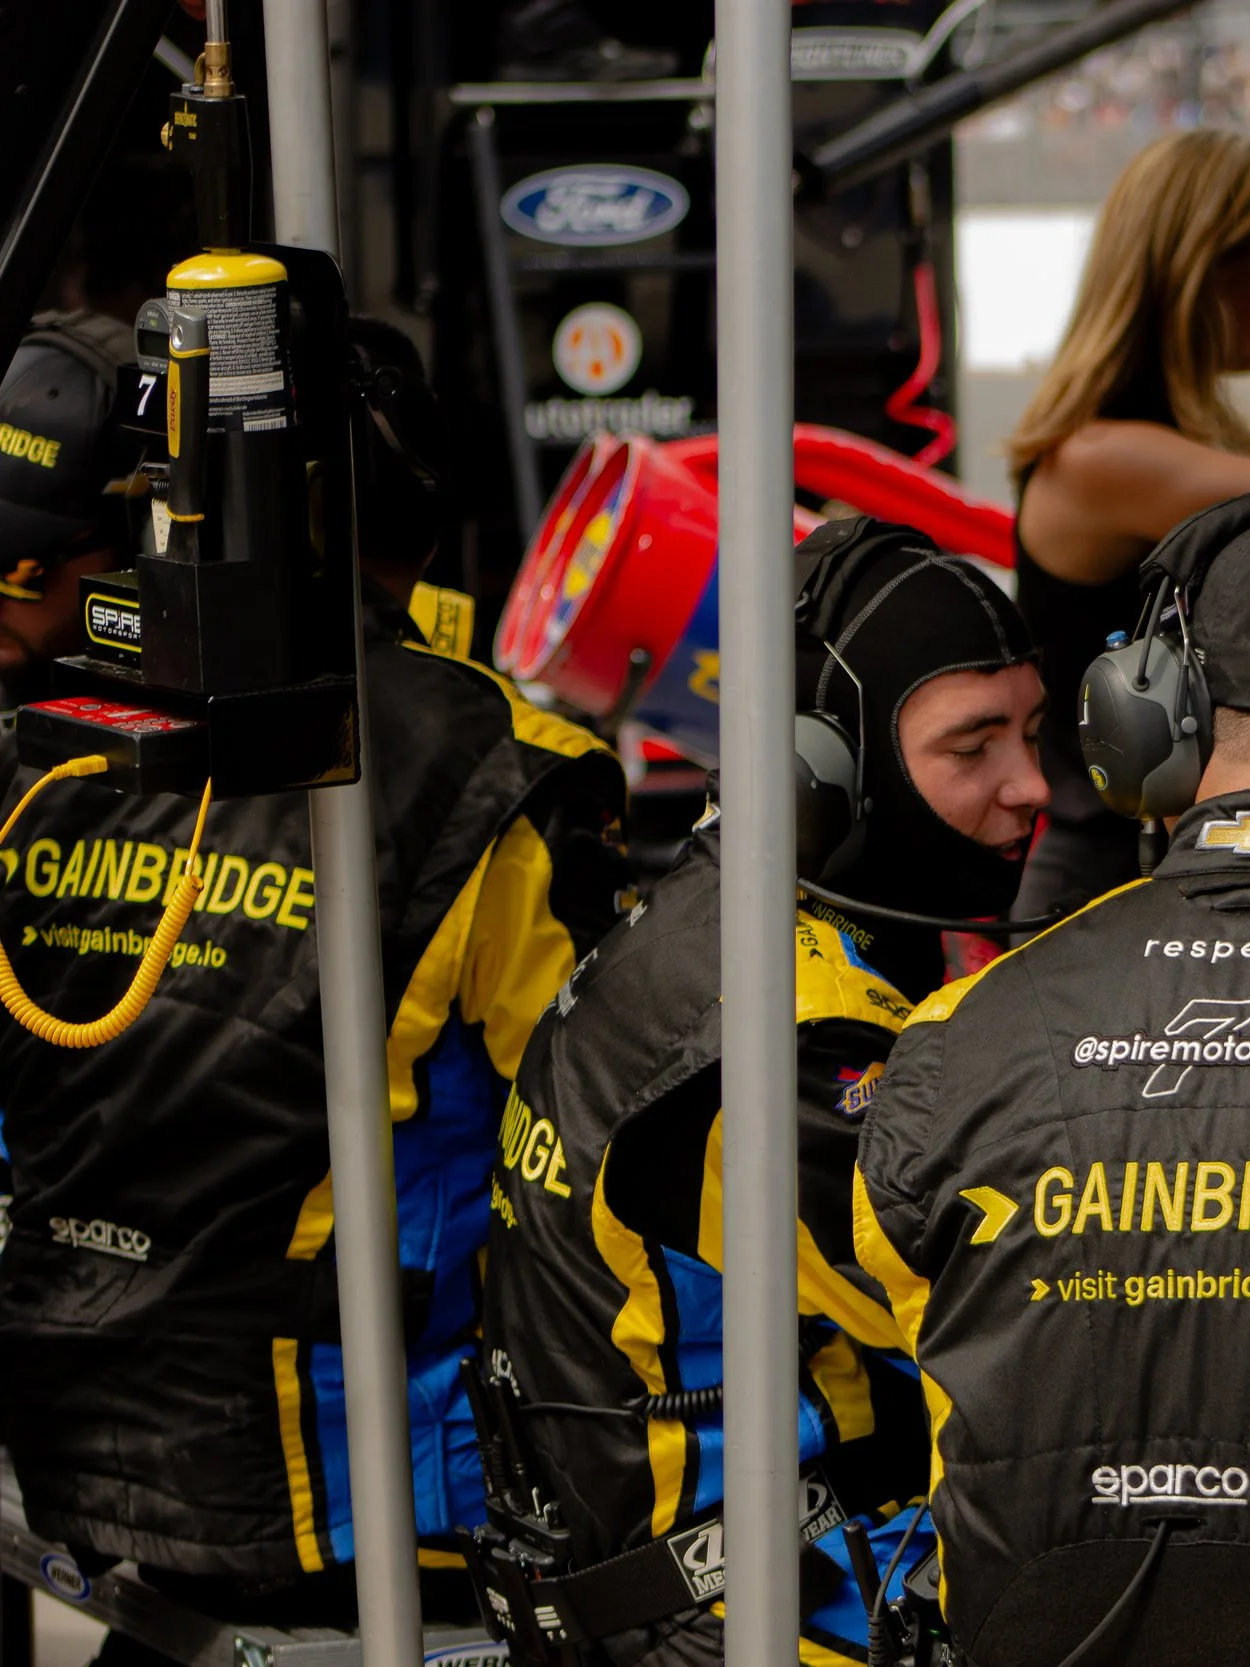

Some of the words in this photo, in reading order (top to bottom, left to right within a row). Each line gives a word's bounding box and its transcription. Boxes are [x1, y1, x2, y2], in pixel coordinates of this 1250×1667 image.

[136, 373, 158, 416] 7
[49, 1216, 152, 1262] sparco
[1057, 1270, 1118, 1301] visit
[1091, 1464, 1250, 1507] sparco
